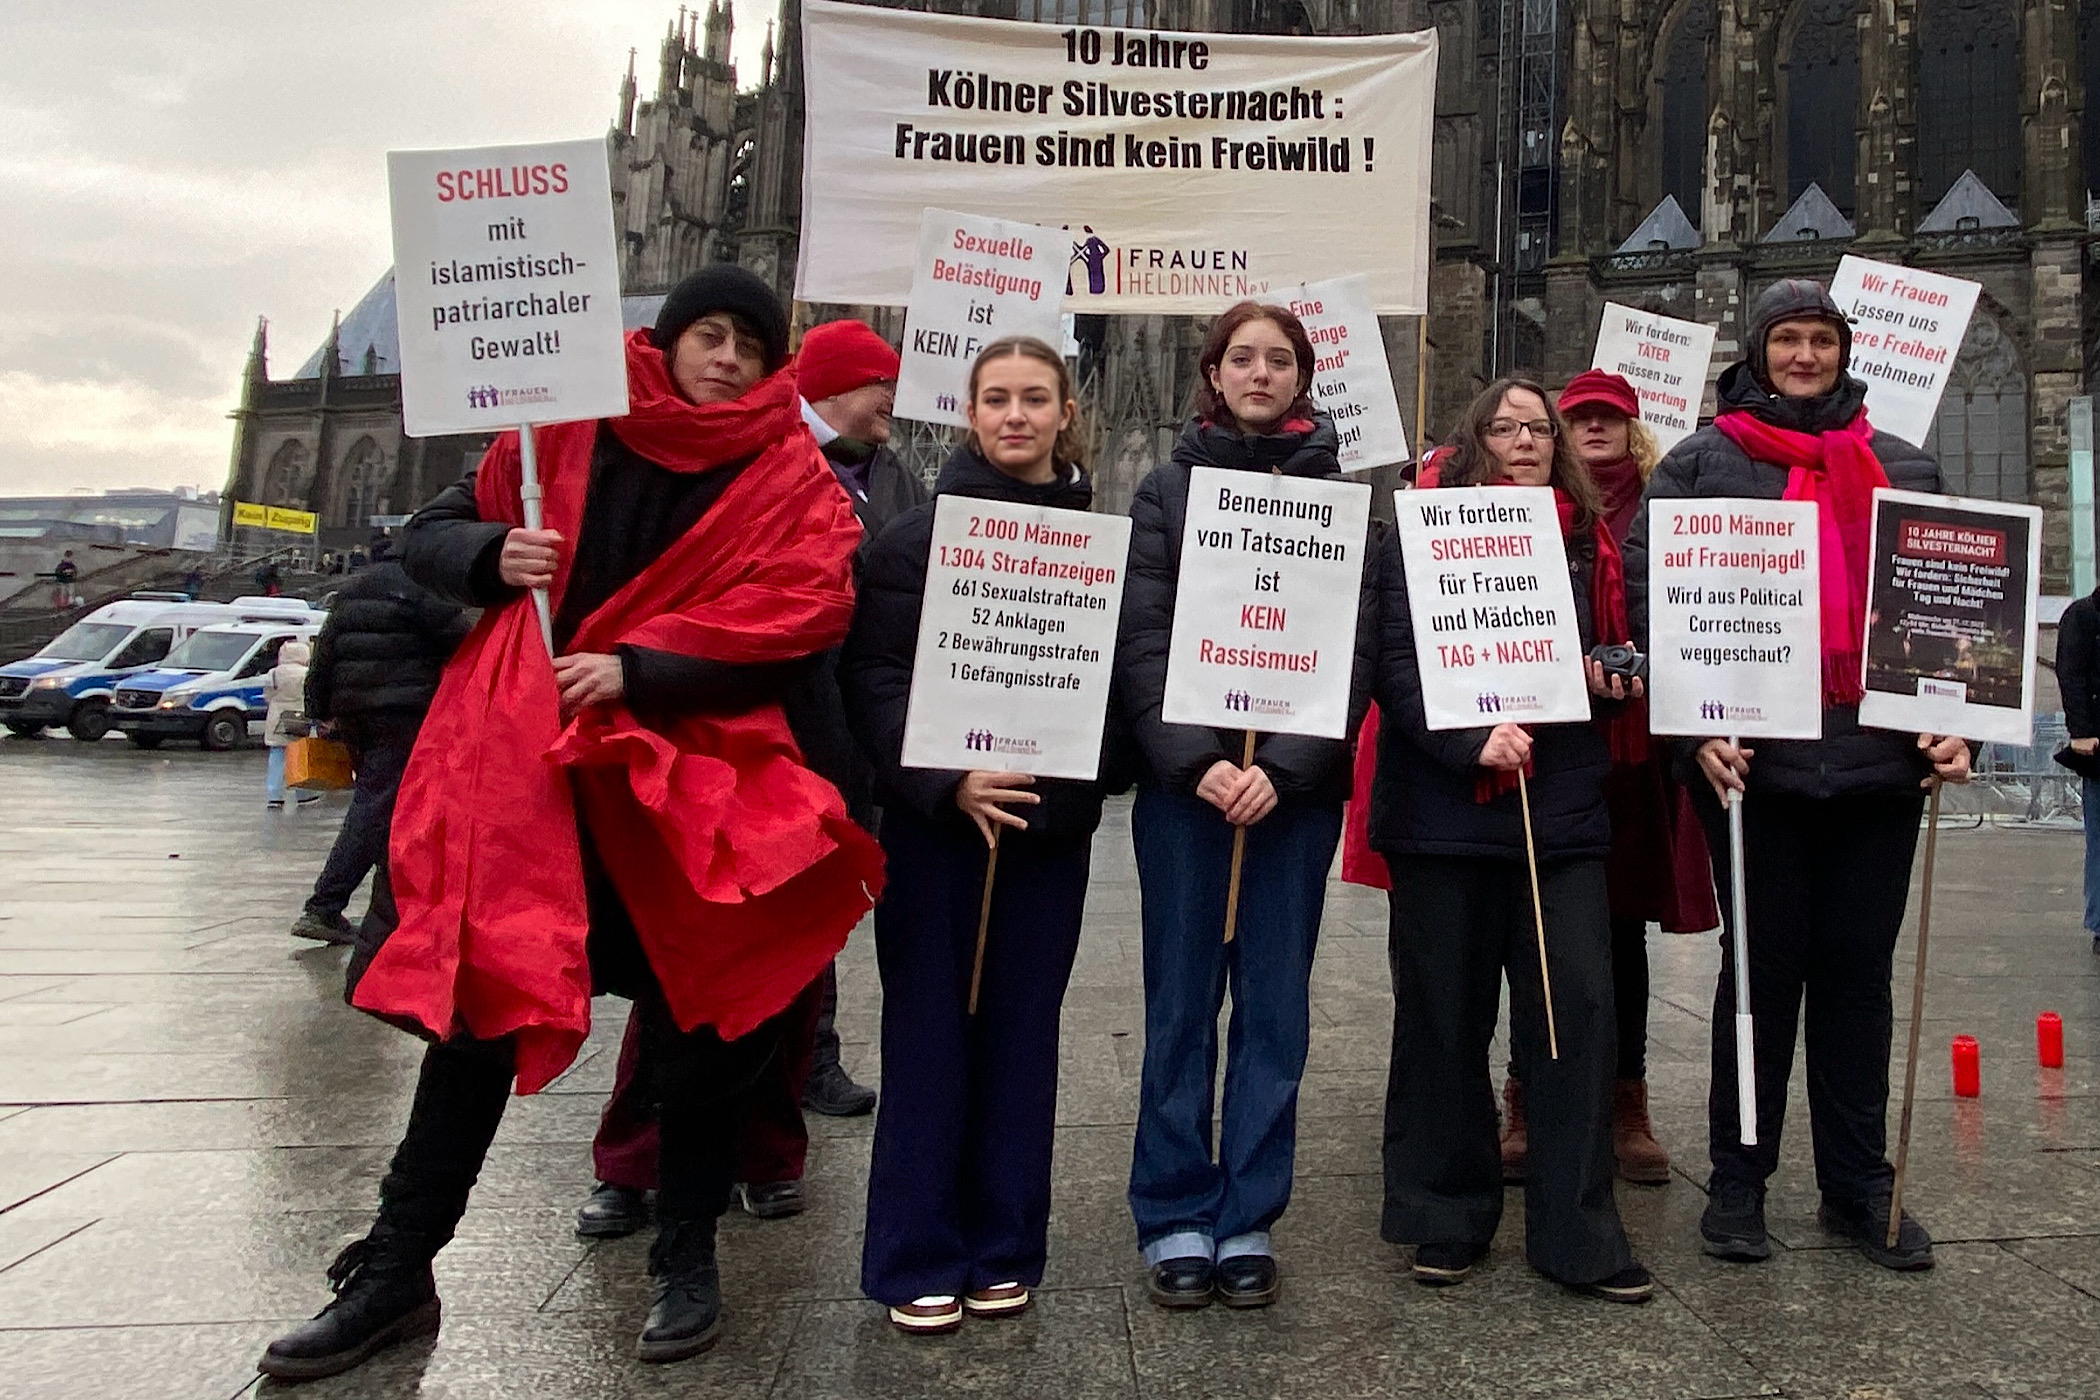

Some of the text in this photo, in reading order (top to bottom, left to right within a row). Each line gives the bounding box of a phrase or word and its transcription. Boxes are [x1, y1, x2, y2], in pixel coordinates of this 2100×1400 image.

[1061, 29, 1209, 71] 10 Jahre
[928, 69, 1055, 114] Kölner
[1062, 81, 1324, 122] Silvesternacht
[895, 123, 1026, 165] Frauen
[1035, 132, 1115, 168] sind
[1125, 134, 1201, 169] kein
[1212, 137, 1351, 173] Freiwild
[436, 163, 569, 203] SCHLUSS
[487, 216, 527, 242] mit
[953, 228, 1034, 261] Sexuelle
[430, 252, 586, 285] islamistisch-
[1129, 248, 1248, 271] FRAUEN
[932, 258, 1043, 302] Belästigung
[1129, 272, 1248, 297] HELDINNEN
[1860, 273, 1949, 307] Wir Frauen
[432, 290, 592, 331] patriarchaler
[967, 300, 995, 325] ist
[1289, 300, 1324, 318] Eine
[1851, 299, 1940, 333] lassen uns
[1308, 325, 1348, 345] änge
[1625, 318, 1644, 335] Wir
[470, 330, 561, 360] Gewalt!
[913, 328, 959, 359] KEIN
[1637, 341, 1671, 363] TÄTER
[1852, 331, 1879, 348] ere
[1883, 333, 1948, 364] Freiheit
[1617, 362, 1682, 386] müssen zur
[1862, 360, 1936, 390] nehmen!
[1316, 379, 1347, 398] kein
[1637, 385, 1687, 412] twortung
[1327, 402, 1369, 420] heits-
[1644, 410, 1688, 431] werden.
[1337, 425, 1362, 448] ept!
[1218, 487, 1333, 528] Benennung
[1420, 502, 1533, 527] Wir fordern:
[968, 516, 1092, 549] 2.000 Männer
[1673, 514, 1796, 537] 2.000 Männer
[1907, 526, 1997, 546] 10 JAHRE KÖLNER
[1197, 528, 1346, 562] von Tatsachen
[1431, 535, 1533, 561] SICHERHEIT
[1906, 538, 1996, 558] SILVESTERNACHT
[939, 545, 1117, 587] 1.304 Strafanzeigen
[1664, 547, 1806, 575] auf Frauenjagd!
[1254, 567, 1281, 593] ist
[1438, 571, 1539, 596] für Frauen
[951, 578, 1107, 611] 661 Sexualstraftaten
[1667, 586, 1804, 607] Wird aus Political
[971, 607, 1066, 635] 52 Anklagen
[1240, 604, 1287, 632] KEIN
[1432, 605, 1557, 632] und Mädchen
[1689, 614, 1782, 635] Correctness
[938, 632, 1100, 663] 2 Bewährungsstrafen
[1199, 639, 1319, 674] Rassismus!
[1437, 644, 1476, 670] TAG
[1496, 640, 1561, 665] NACHT.
[1680, 644, 1792, 666] weggeschaut?
[950, 662, 1082, 691] 1 Gefängnisstrafe
